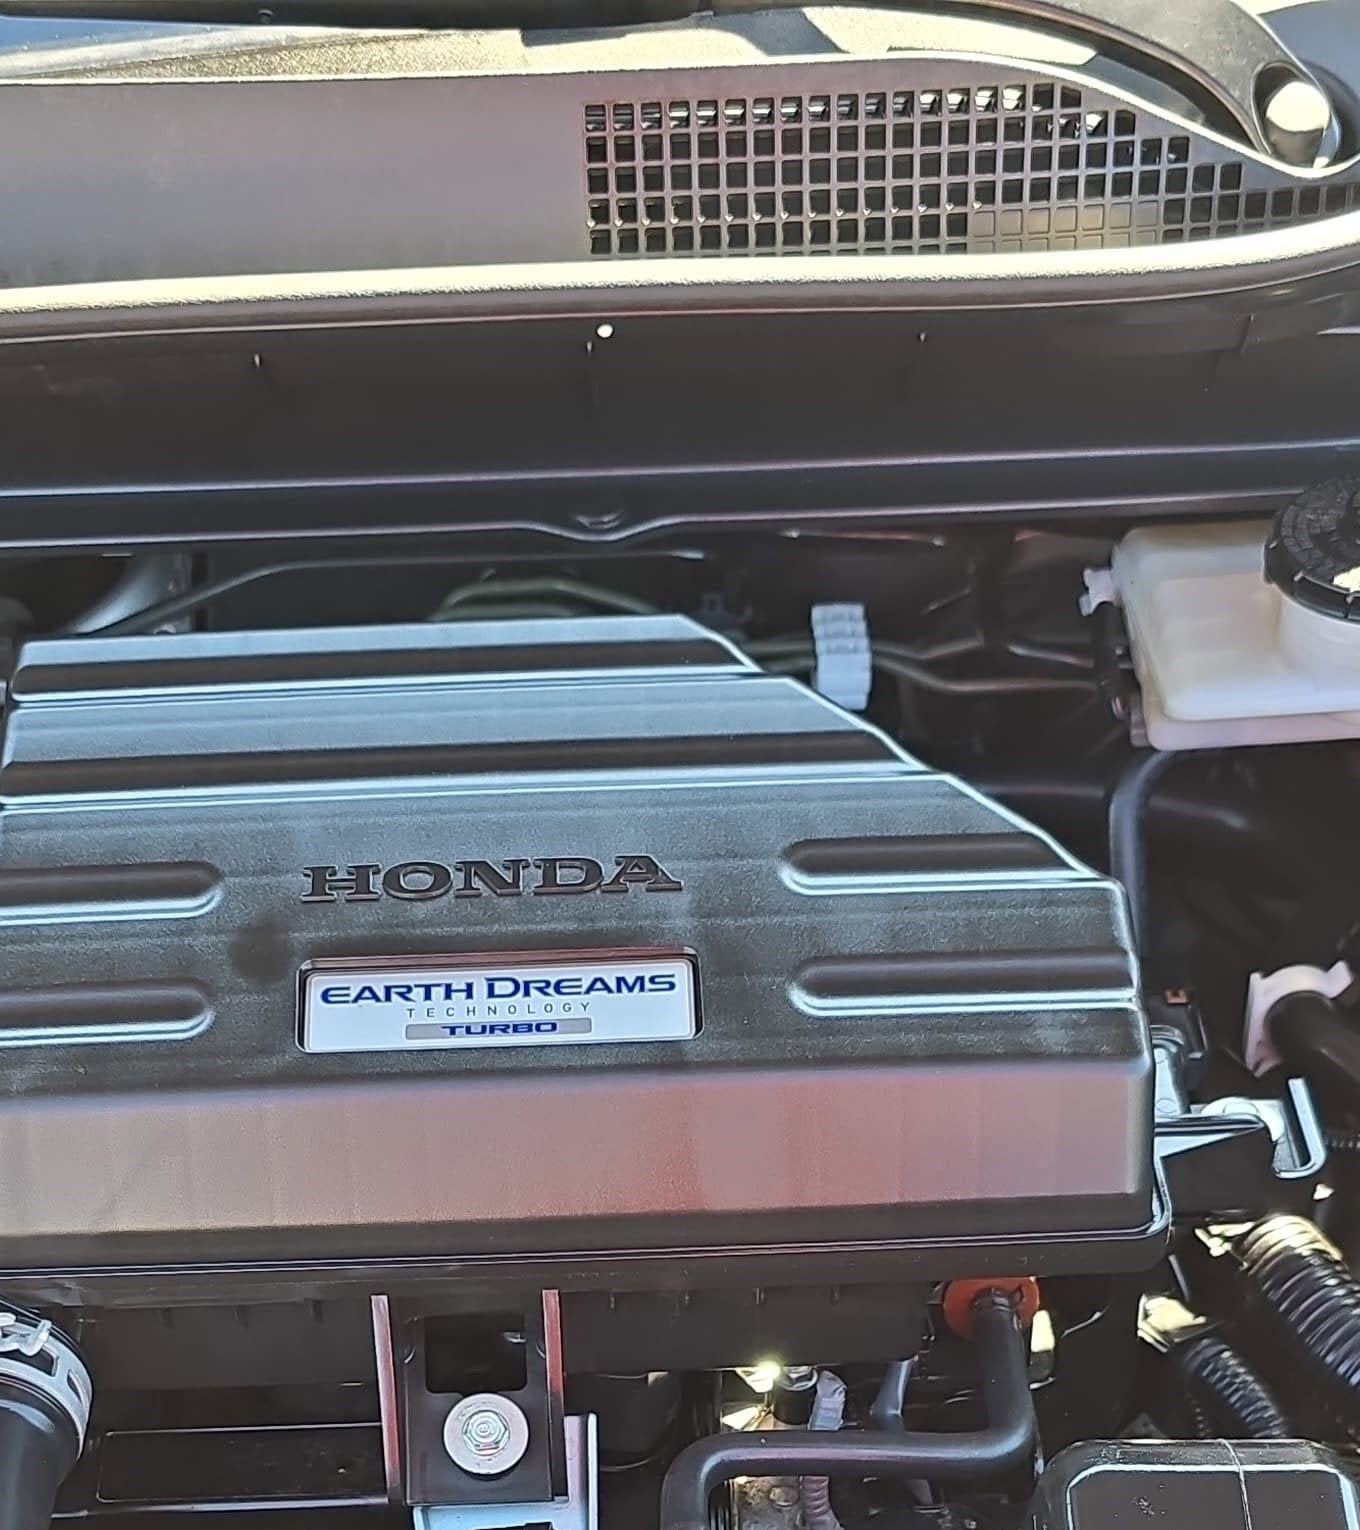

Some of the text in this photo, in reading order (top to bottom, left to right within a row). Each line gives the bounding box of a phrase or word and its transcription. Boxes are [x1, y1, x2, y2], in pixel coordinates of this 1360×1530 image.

[300, 854, 683, 902] HONDA
[320, 973, 677, 1005] EARTH DREAMS
[405, 1001, 591, 1019] TECHNOLOGY
[440, 1022, 559, 1037] TURBO
